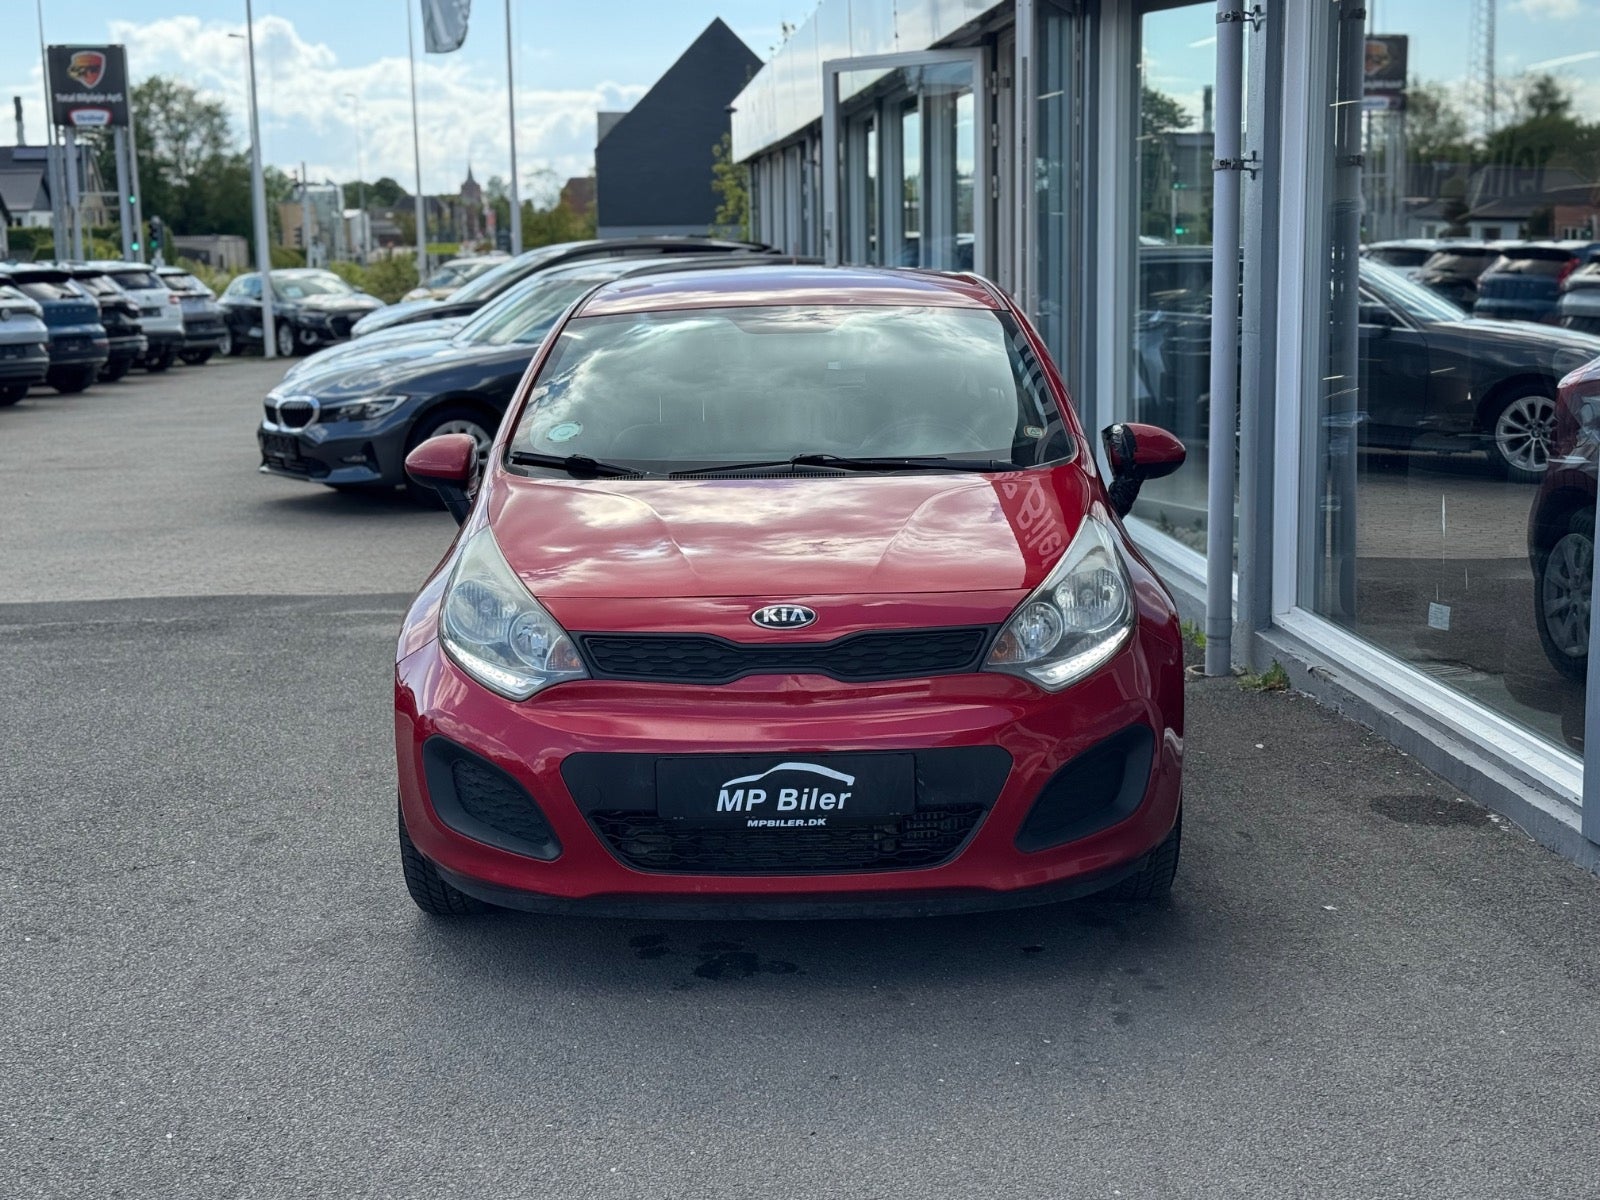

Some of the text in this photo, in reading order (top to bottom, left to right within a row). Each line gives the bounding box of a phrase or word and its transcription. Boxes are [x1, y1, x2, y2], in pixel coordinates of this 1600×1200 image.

[763, 608, 806, 623] KIA
[716, 788, 851, 812] MP Biler
[747, 818, 827, 827] MPBILER.DK
